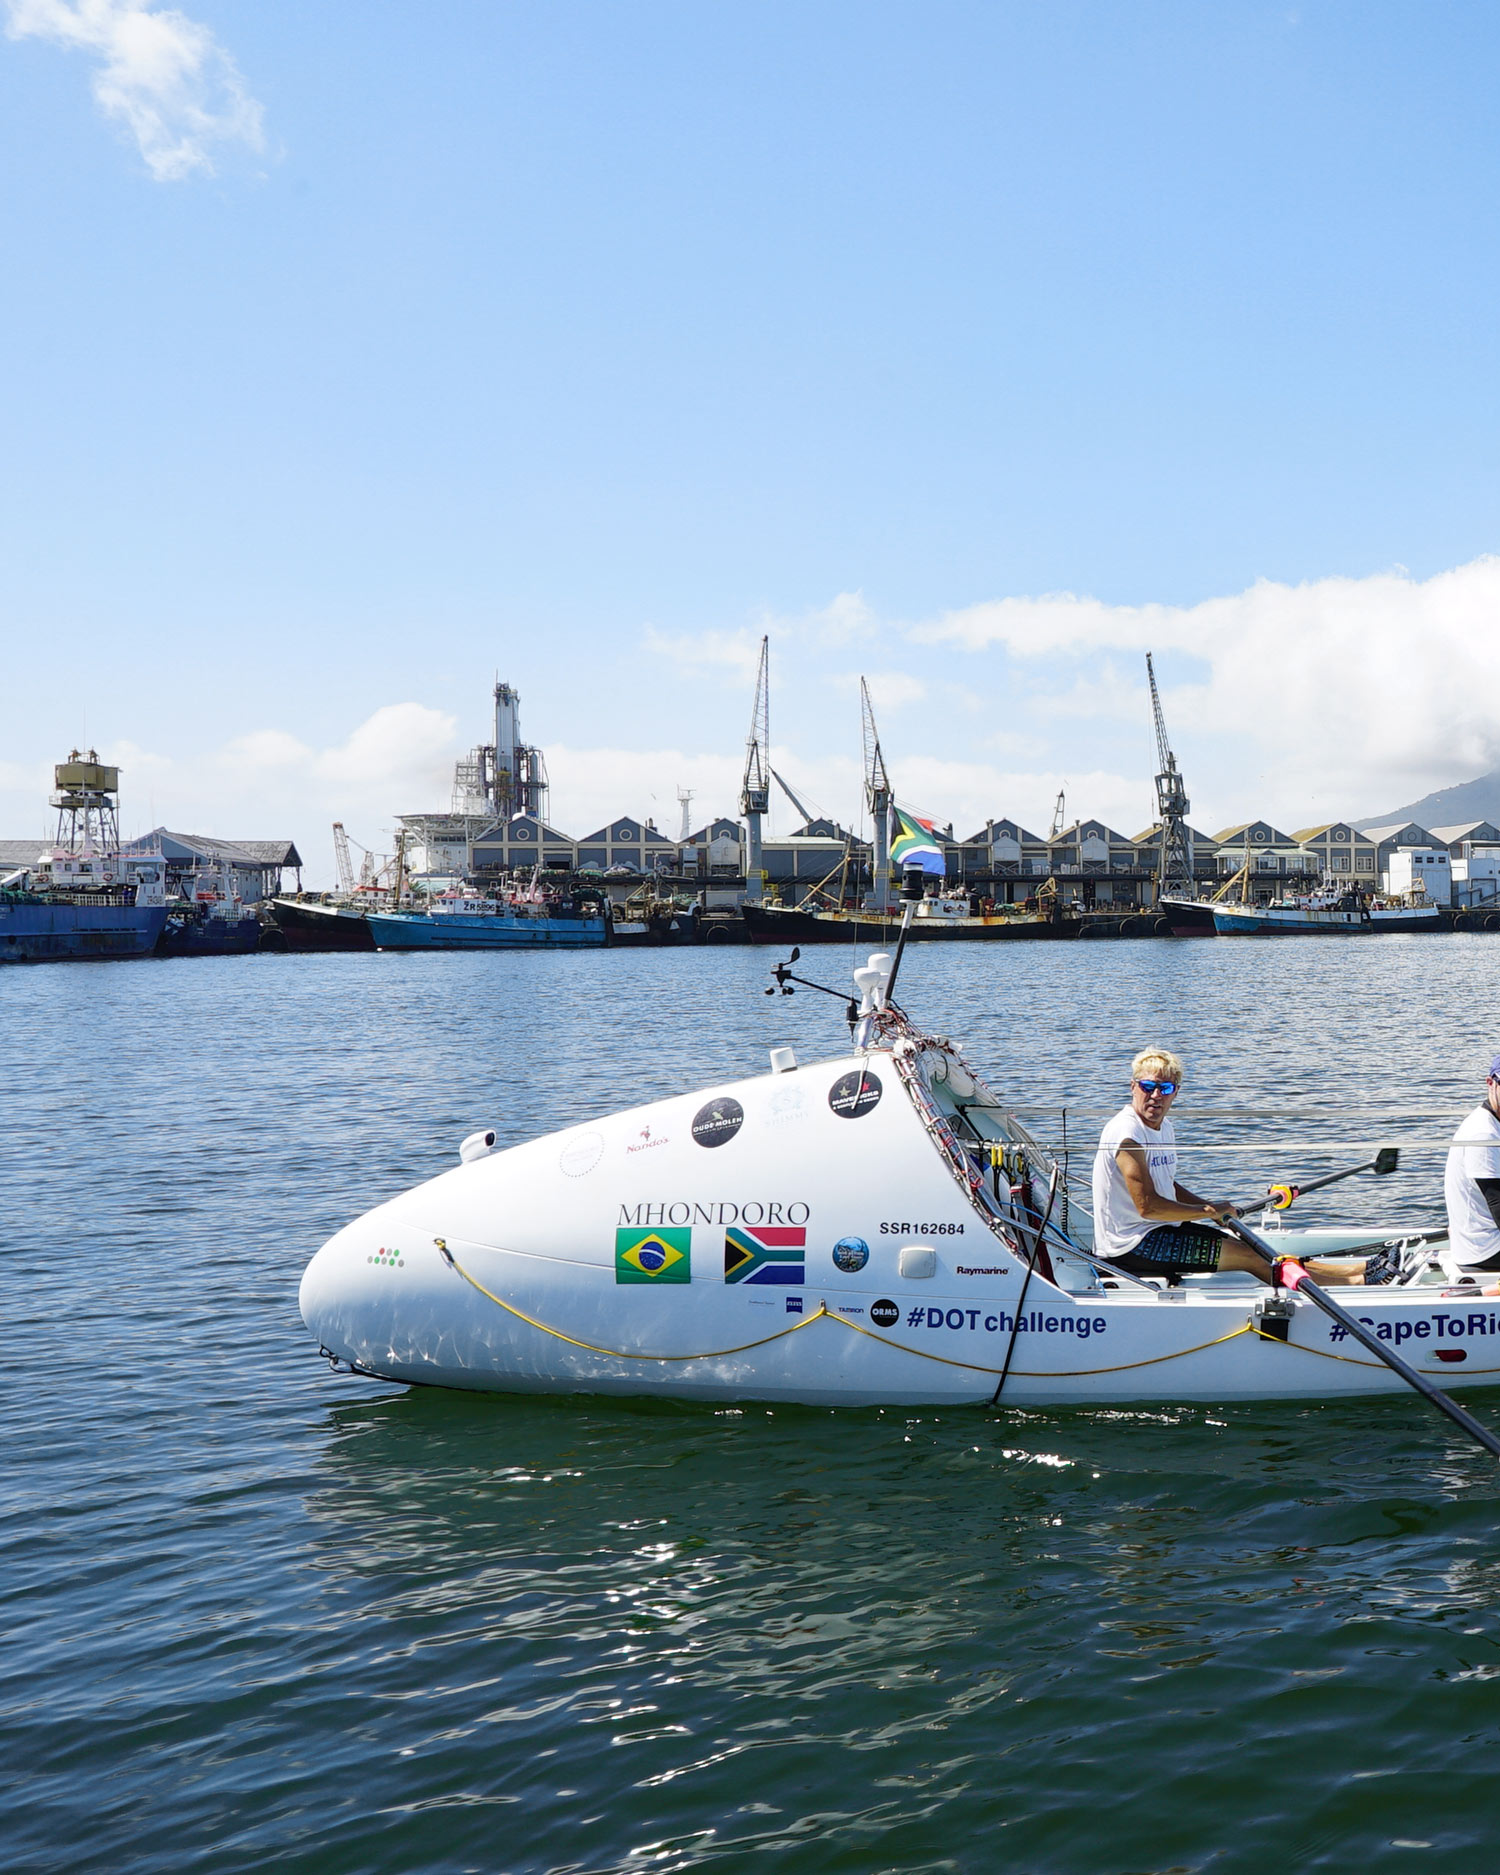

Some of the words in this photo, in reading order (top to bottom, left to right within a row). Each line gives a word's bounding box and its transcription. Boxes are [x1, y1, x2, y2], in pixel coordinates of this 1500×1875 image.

[832, 1091, 880, 1106] MAVEICKS
[693, 1122, 714, 1133] OUDE
[715, 1117, 742, 1127] MOLEN
[626, 1137, 670, 1154] Nando's
[616, 1201, 811, 1226] MHONDORO
[879, 1222, 965, 1235] SSR162684
[956, 1266, 1009, 1276] Raymarine
[872, 1308, 898, 1316] ORMS
[907, 1307, 981, 1330] #DOT
[984, 1311, 1107, 1339] challenge
